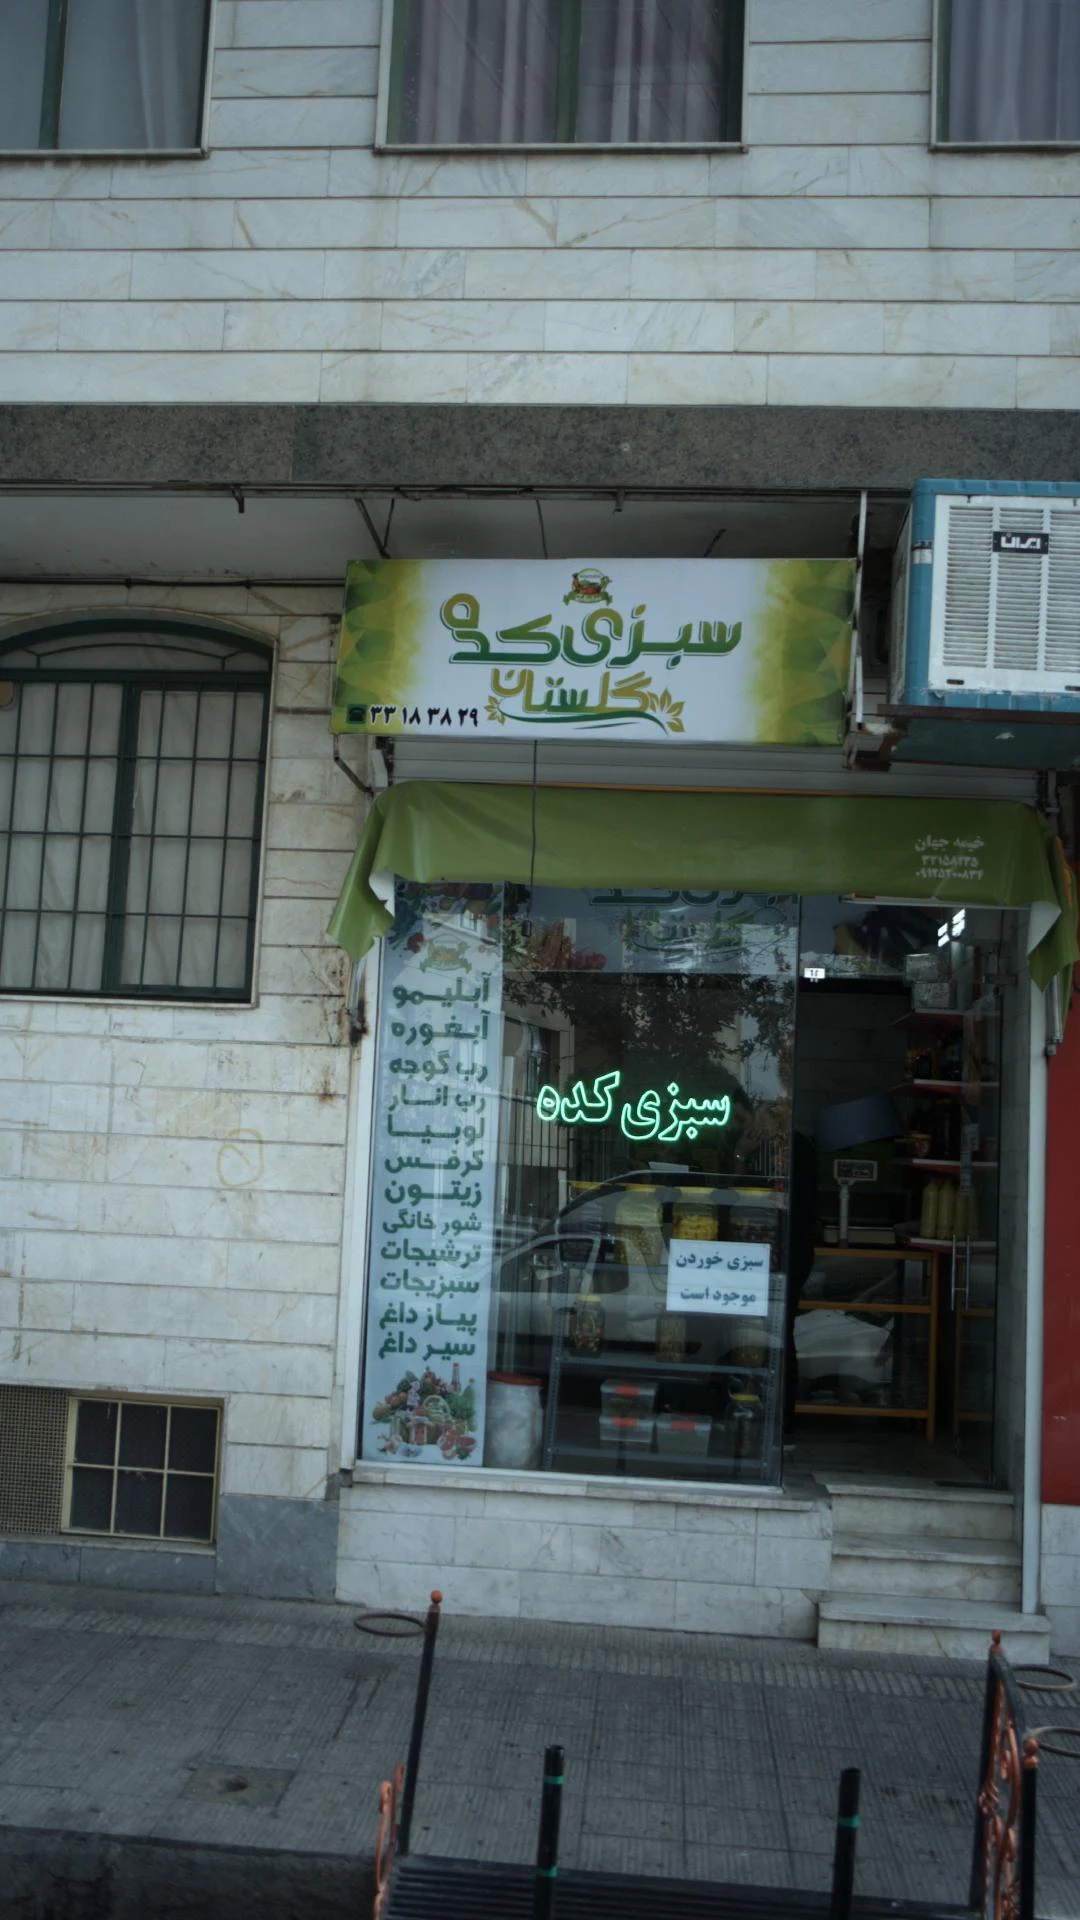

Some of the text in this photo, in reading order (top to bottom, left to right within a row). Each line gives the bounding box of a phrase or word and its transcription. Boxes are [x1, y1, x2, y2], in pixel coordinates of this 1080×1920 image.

[440, 592, 743, 669] سبزی کده
[490, 669, 653, 715] گلستان
[392, 972, 492, 1009] آبلیمو
[391, 1010, 491, 1045] آبغوره
[389, 1050, 488, 1083] رب گوجه
[388, 1084, 486, 1113] رب انار
[536, 1070, 731, 1141] سبزی کده
[387, 1114, 485, 1146] لوبیا
[384, 1150, 484, 1178] کرفس
[384, 1179, 482, 1208] زیتون
[382, 1208, 482, 1236] شور خانگی
[380, 1238, 482, 1269] ترشیجات
[676, 1251, 764, 1271] سبزی خوردن
[380, 1269, 480, 1299] سبزیجات
[680, 1286, 757, 1306] موجود است
[378, 1302, 478, 1336] پیاز داغ
[378, 1331, 476, 1361] سیر داغ
